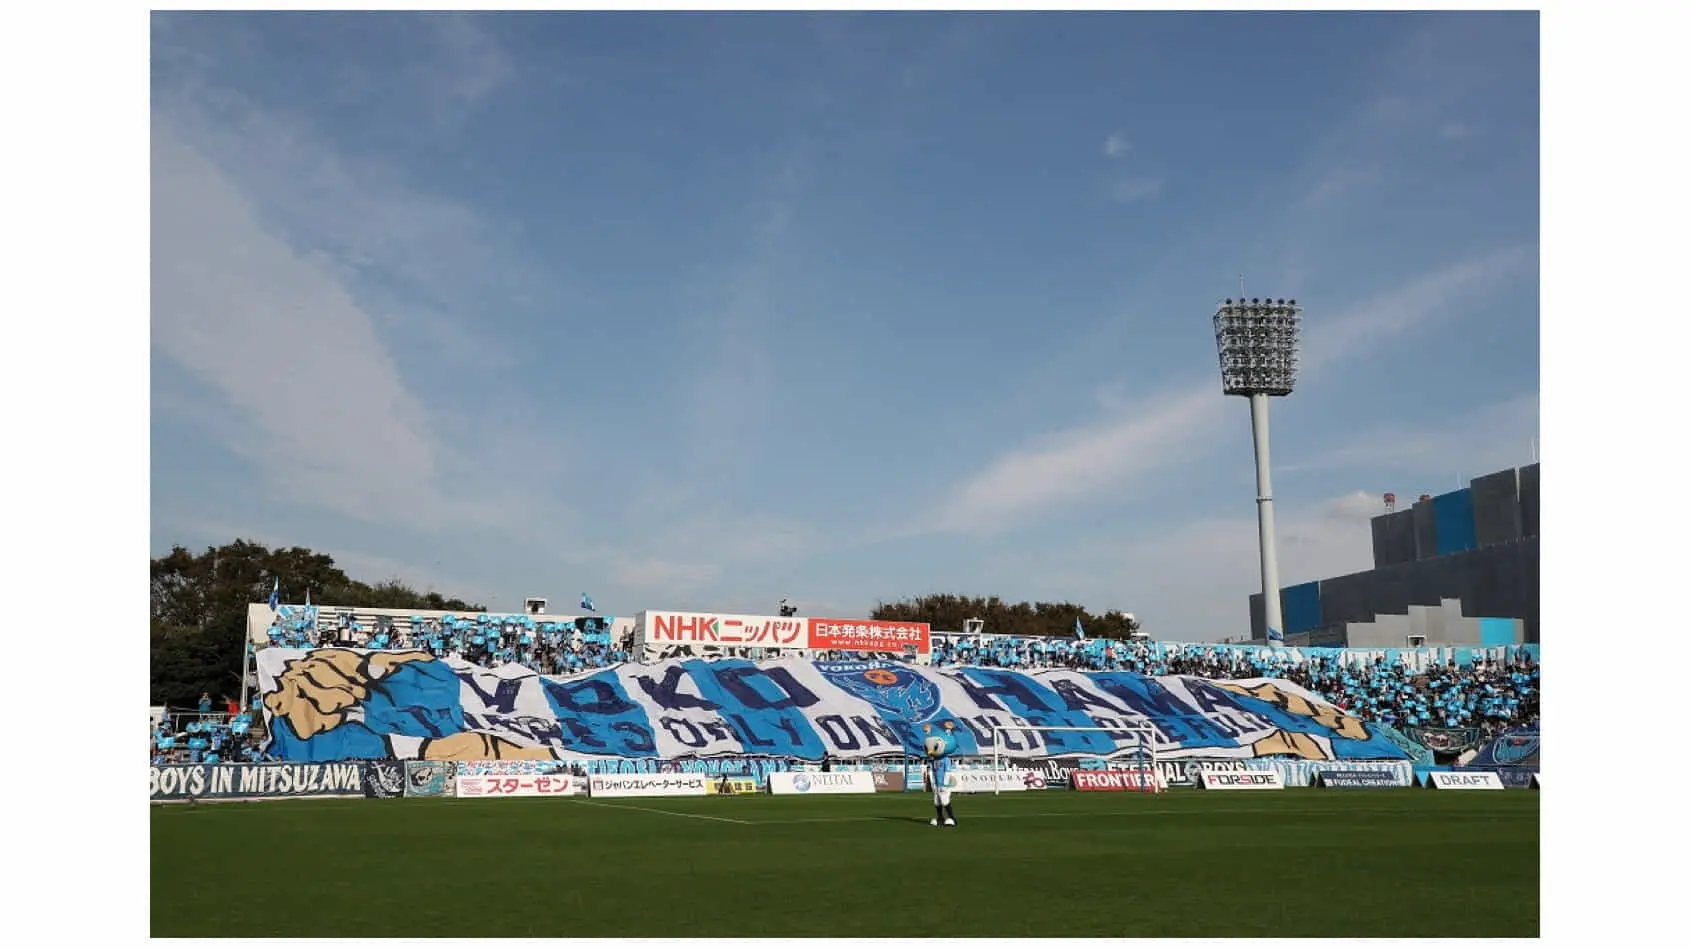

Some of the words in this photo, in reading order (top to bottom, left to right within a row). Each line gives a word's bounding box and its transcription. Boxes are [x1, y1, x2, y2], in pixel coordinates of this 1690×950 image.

[815, 622, 922, 641] 日本発条株式会社
[150, 766, 204, 795] BOYS
[211, 766, 234, 793] IN
[239, 764, 362, 793] MITSUZAWA
[487, 778, 569, 793] スターゼン
[604, 779, 704, 790] ジャパンエレベーターサービス
[1076, 773, 1156, 788] FRONTIER
[1208, 774, 1277, 785] FORSIDE
[1439, 775, 1490, 786] DRAFT
